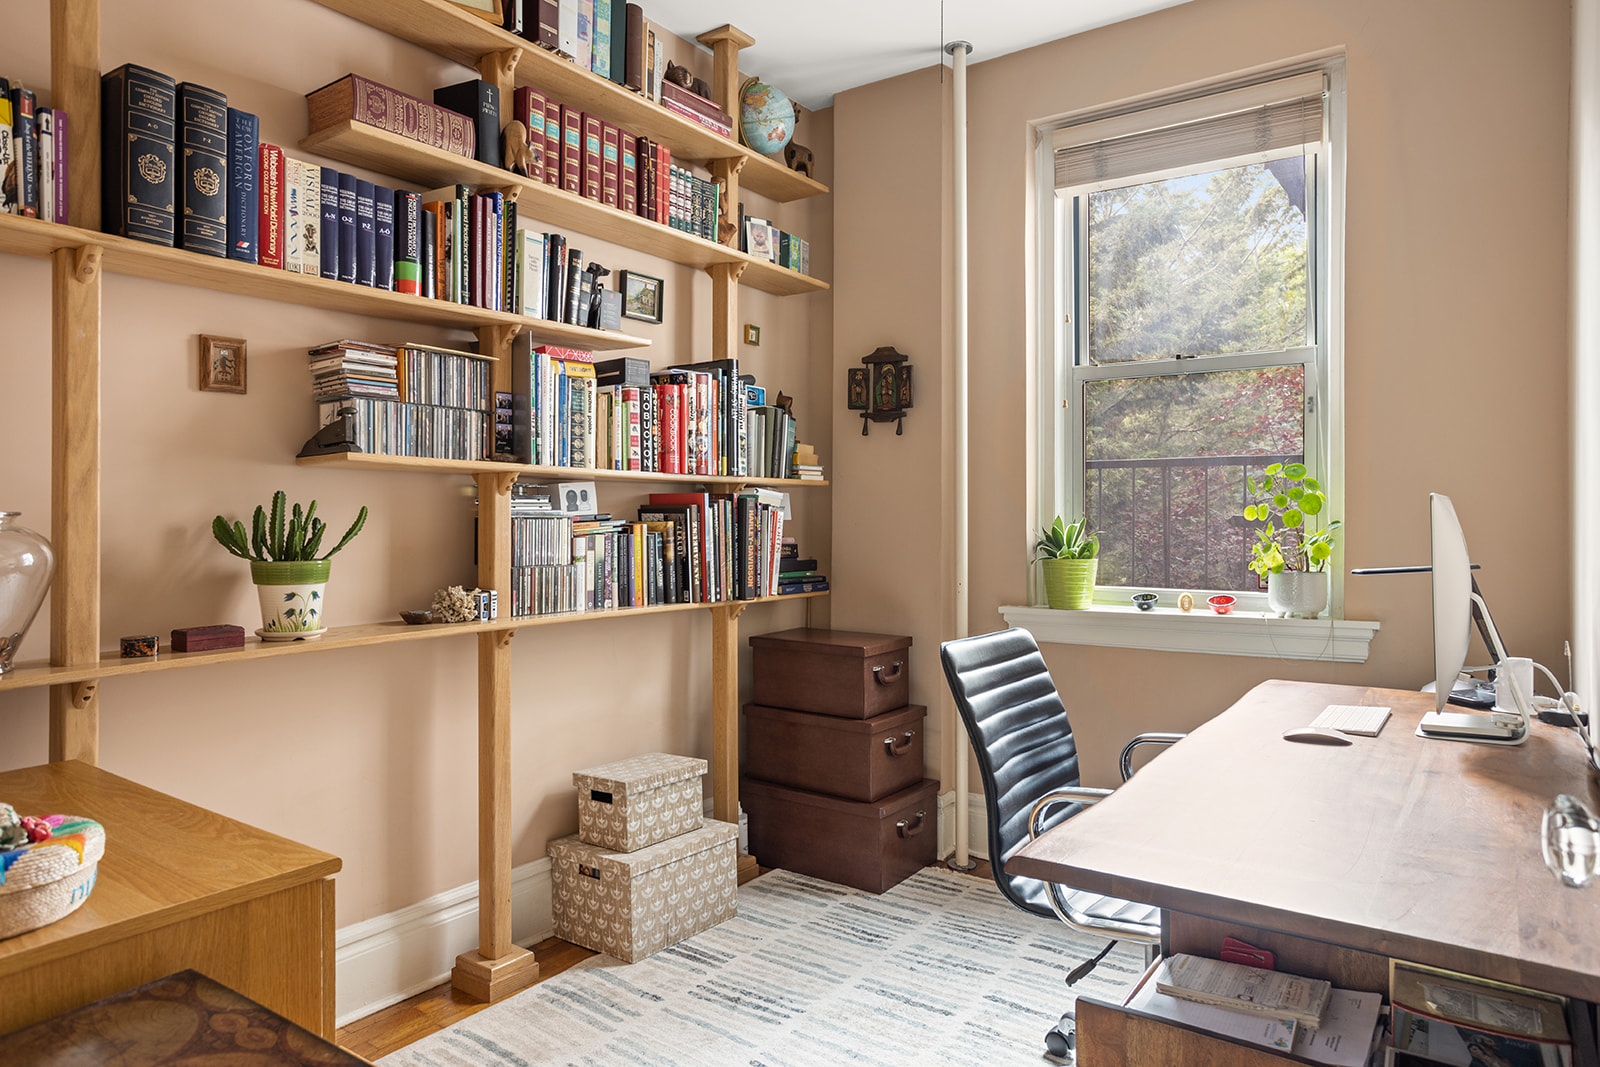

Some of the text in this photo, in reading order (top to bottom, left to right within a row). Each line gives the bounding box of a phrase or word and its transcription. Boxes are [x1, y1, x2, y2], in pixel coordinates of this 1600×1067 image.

[235, 131, 243, 189] AMERICAN
[243, 134, 252, 191] OXFORD
[269, 149, 279, 185] Webster's
[306, 168, 315, 211] VISUAL
[268, 221, 278, 257] Dictionary
